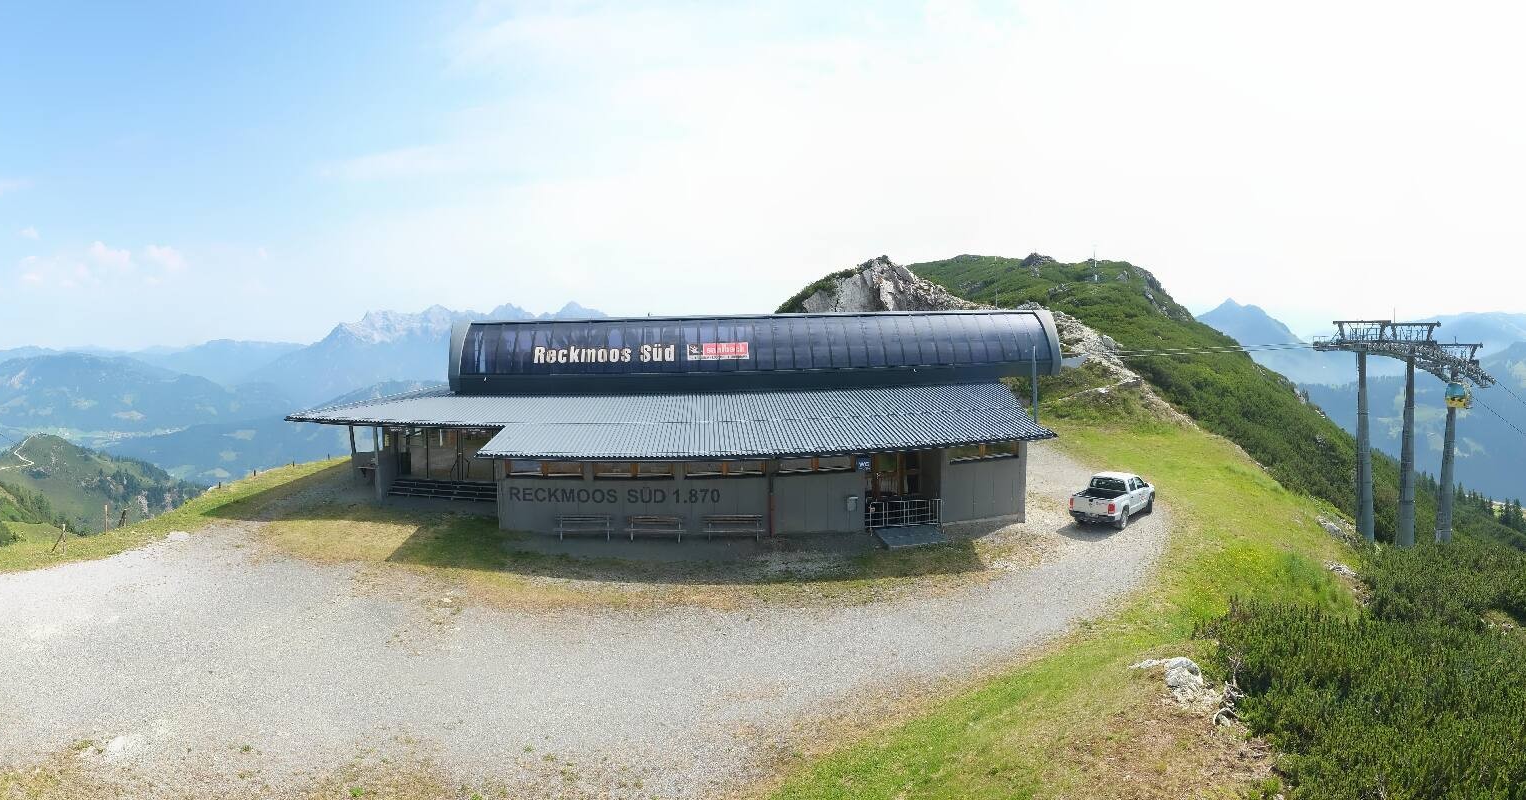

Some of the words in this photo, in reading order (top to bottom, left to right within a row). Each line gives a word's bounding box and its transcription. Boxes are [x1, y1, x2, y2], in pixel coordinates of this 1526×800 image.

[533, 345, 631, 363] Reckmoos
[640, 343, 675, 362] Süd
[509, 486, 618, 504] RECKMOOS
[627, 485, 667, 504] SÜD
[672, 488, 721, 504] 1.870
